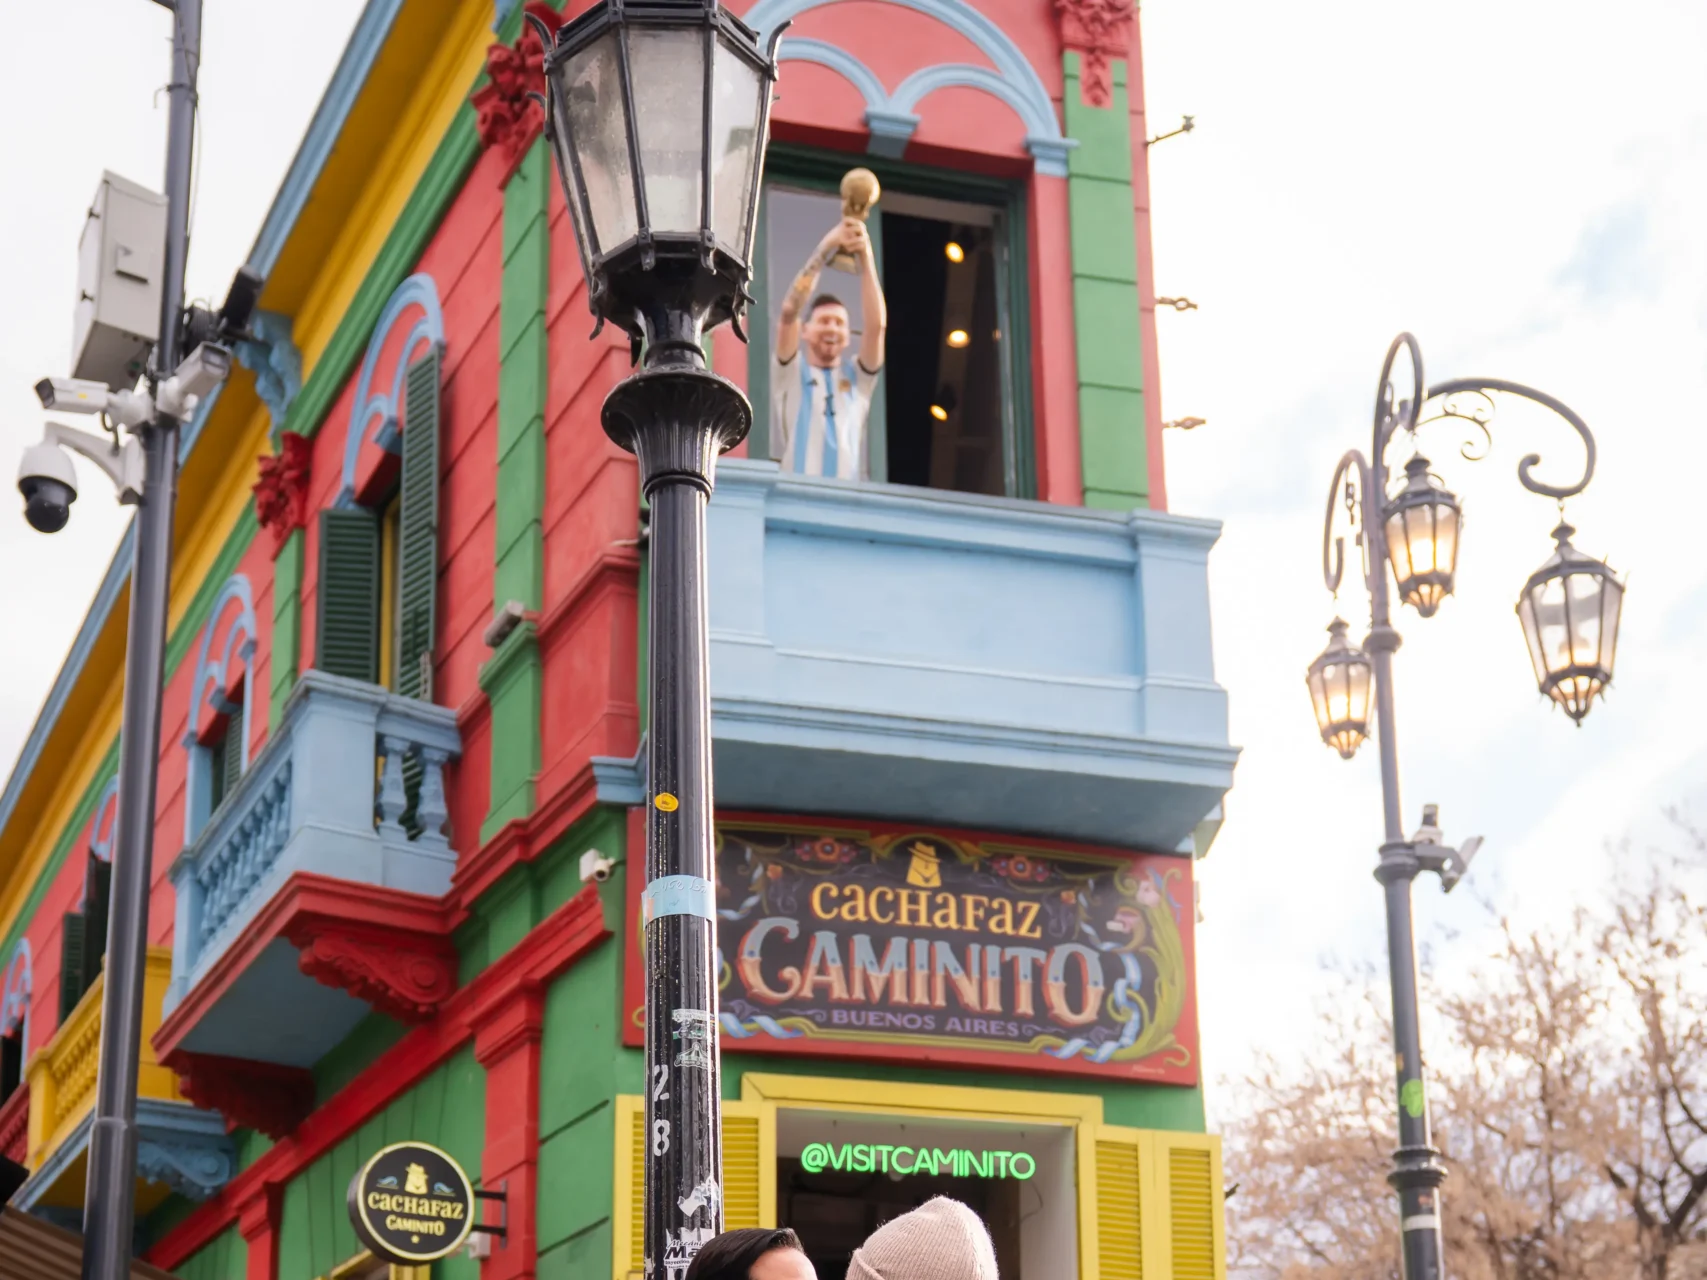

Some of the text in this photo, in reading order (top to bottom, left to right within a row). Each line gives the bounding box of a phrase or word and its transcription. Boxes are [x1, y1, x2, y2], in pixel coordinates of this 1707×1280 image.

[735, 916, 1106, 1027] CAMINITO
[831, 1009, 1019, 1037] BUENOS AIRES
[801, 1142, 1036, 1180] @VISITCAMINITO
[385, 1214, 446, 1236] CAMINITO
